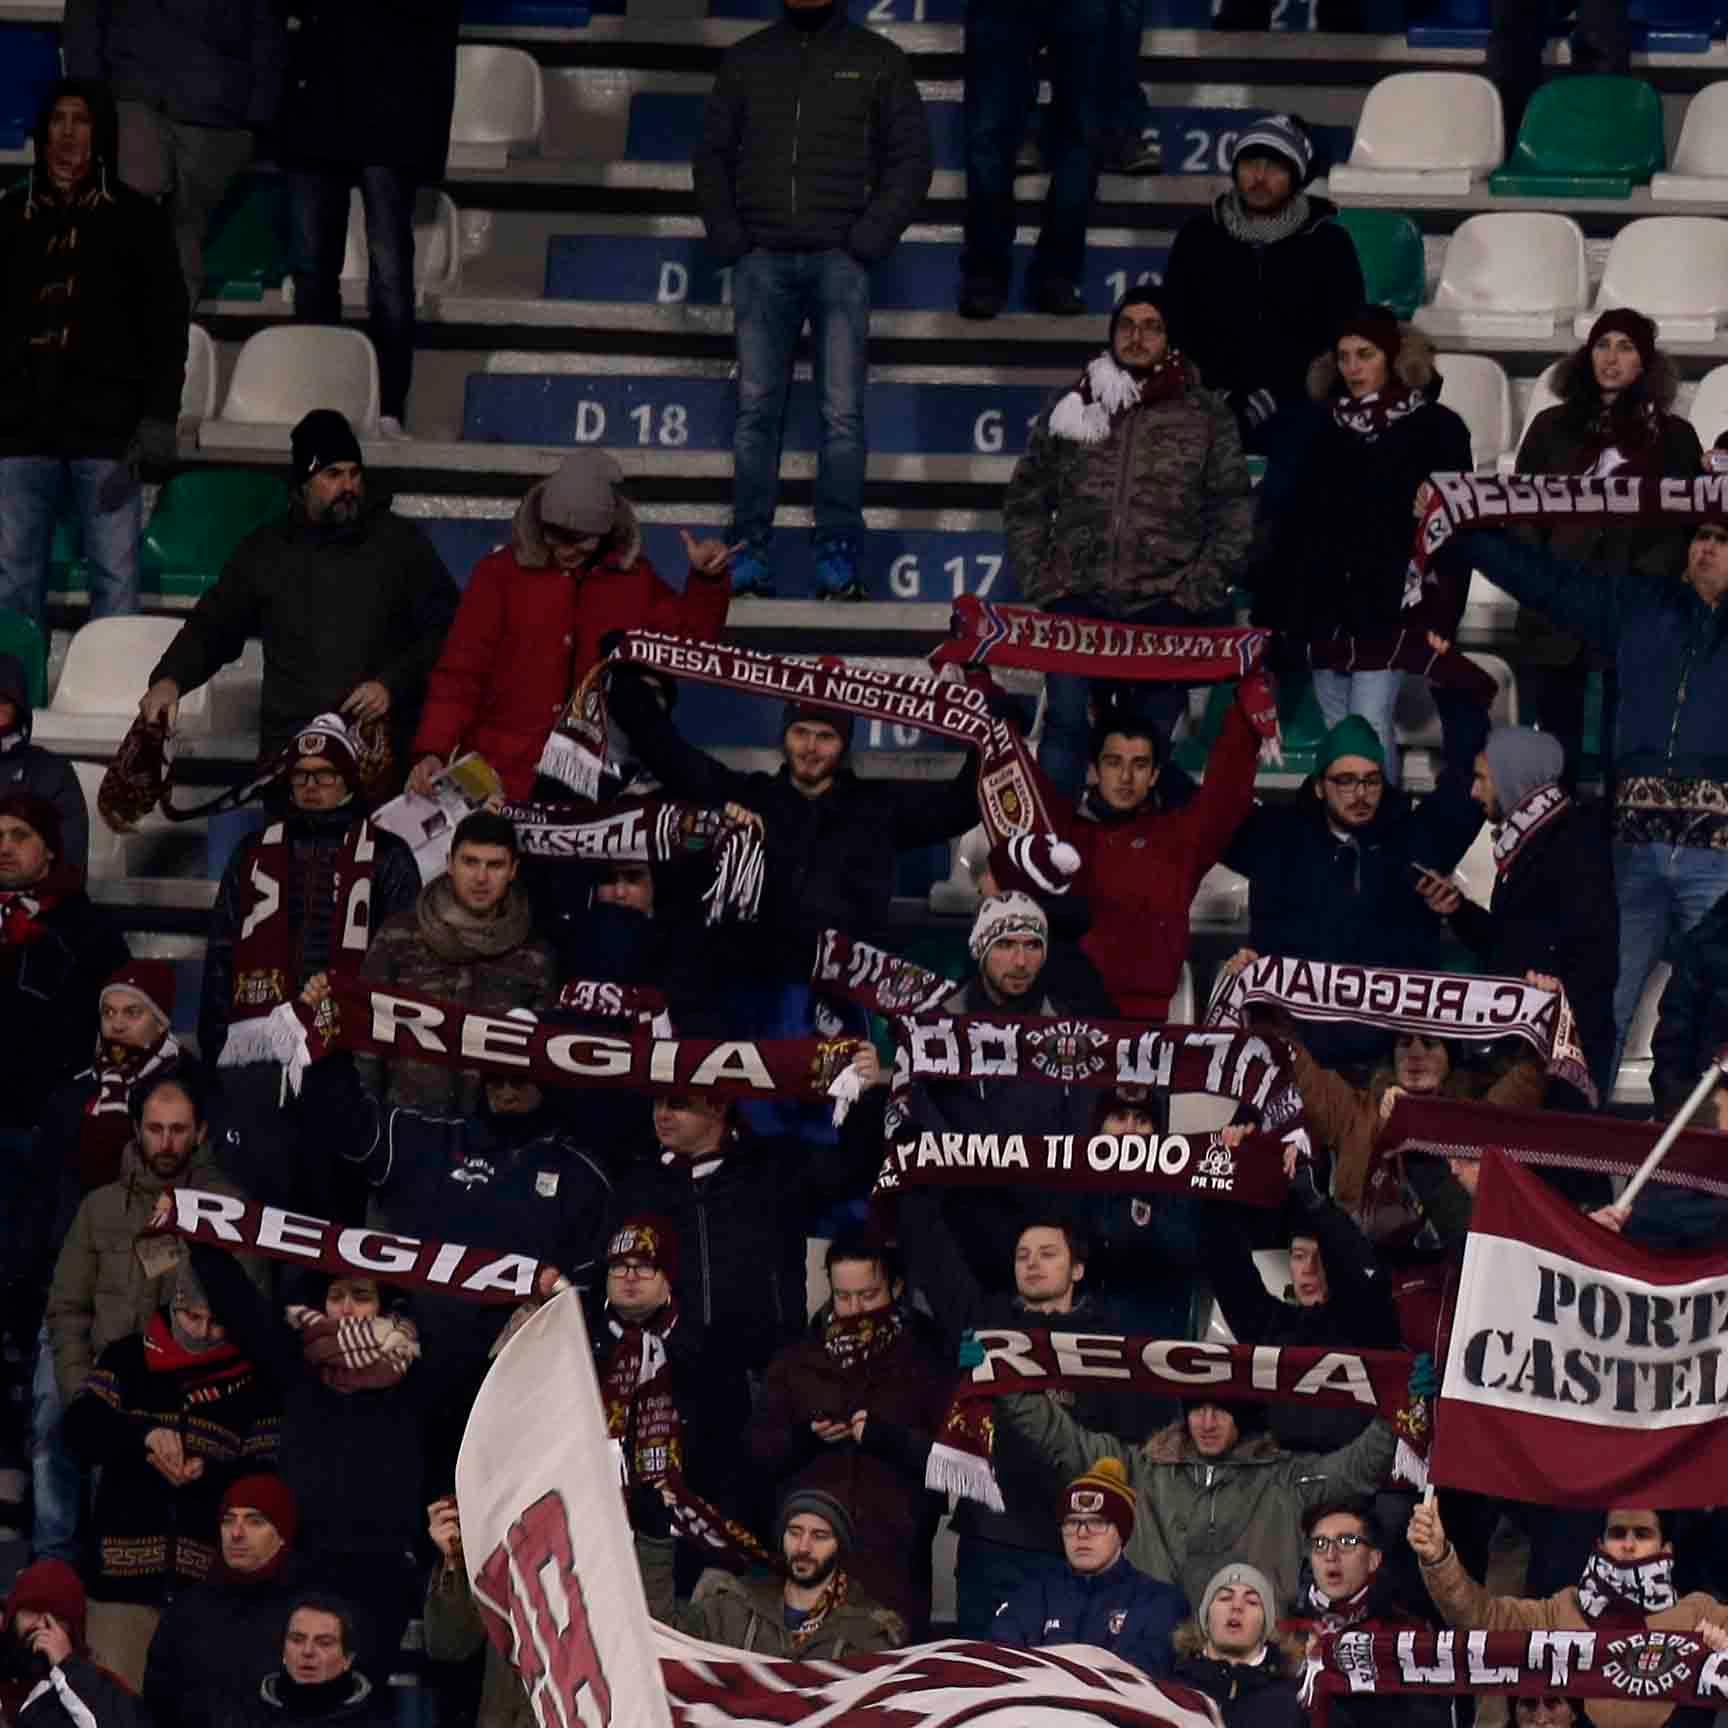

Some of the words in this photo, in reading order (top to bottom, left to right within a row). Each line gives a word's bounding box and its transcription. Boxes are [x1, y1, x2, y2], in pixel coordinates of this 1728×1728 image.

[657, 262, 689, 304] D
[574, 402, 606, 442] D
[630, 404, 688, 446] 18
[973, 411, 1005, 452] G
[889, 554, 921, 596] G
[945, 554, 1003, 595] 17
[629, 638, 724, 677] DIFESA
[731, 658, 818, 697] DELLA
[824, 679, 937, 725] NOSTRA
[369, 990, 777, 1090] REGIA
[1041, 1134, 1073, 1170] TI
[1085, 1134, 1190, 1177] ODIO
[174, 1187, 543, 1297] REGIA
[969, 1329, 1375, 1404] REGIA
